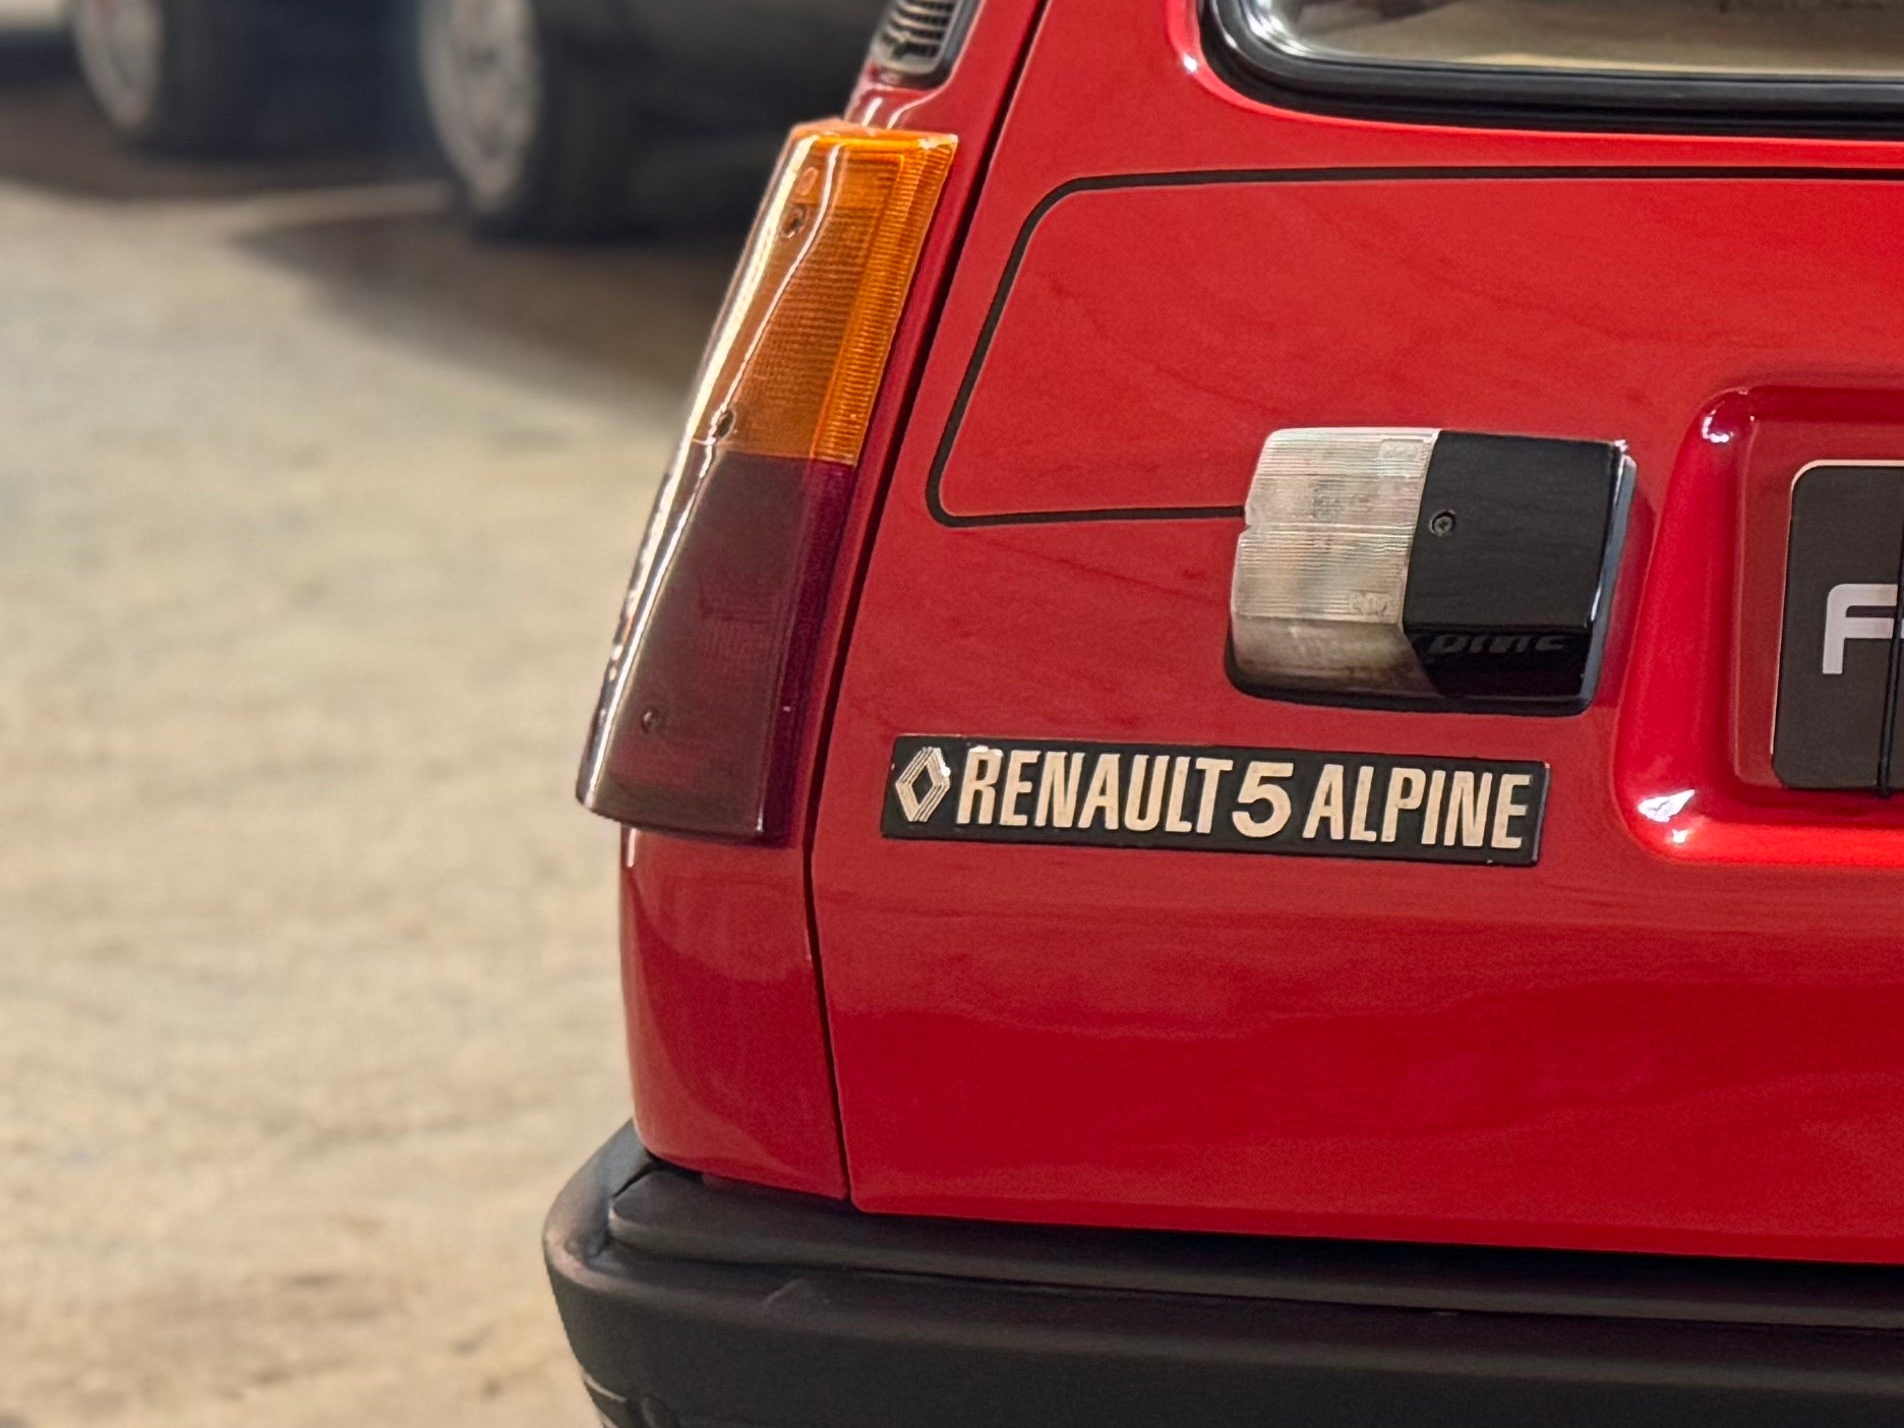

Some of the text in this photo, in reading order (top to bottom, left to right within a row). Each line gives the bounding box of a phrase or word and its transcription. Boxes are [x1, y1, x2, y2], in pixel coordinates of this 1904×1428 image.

[957, 747, 1532, 849] RENAULT 5 ALPINE
